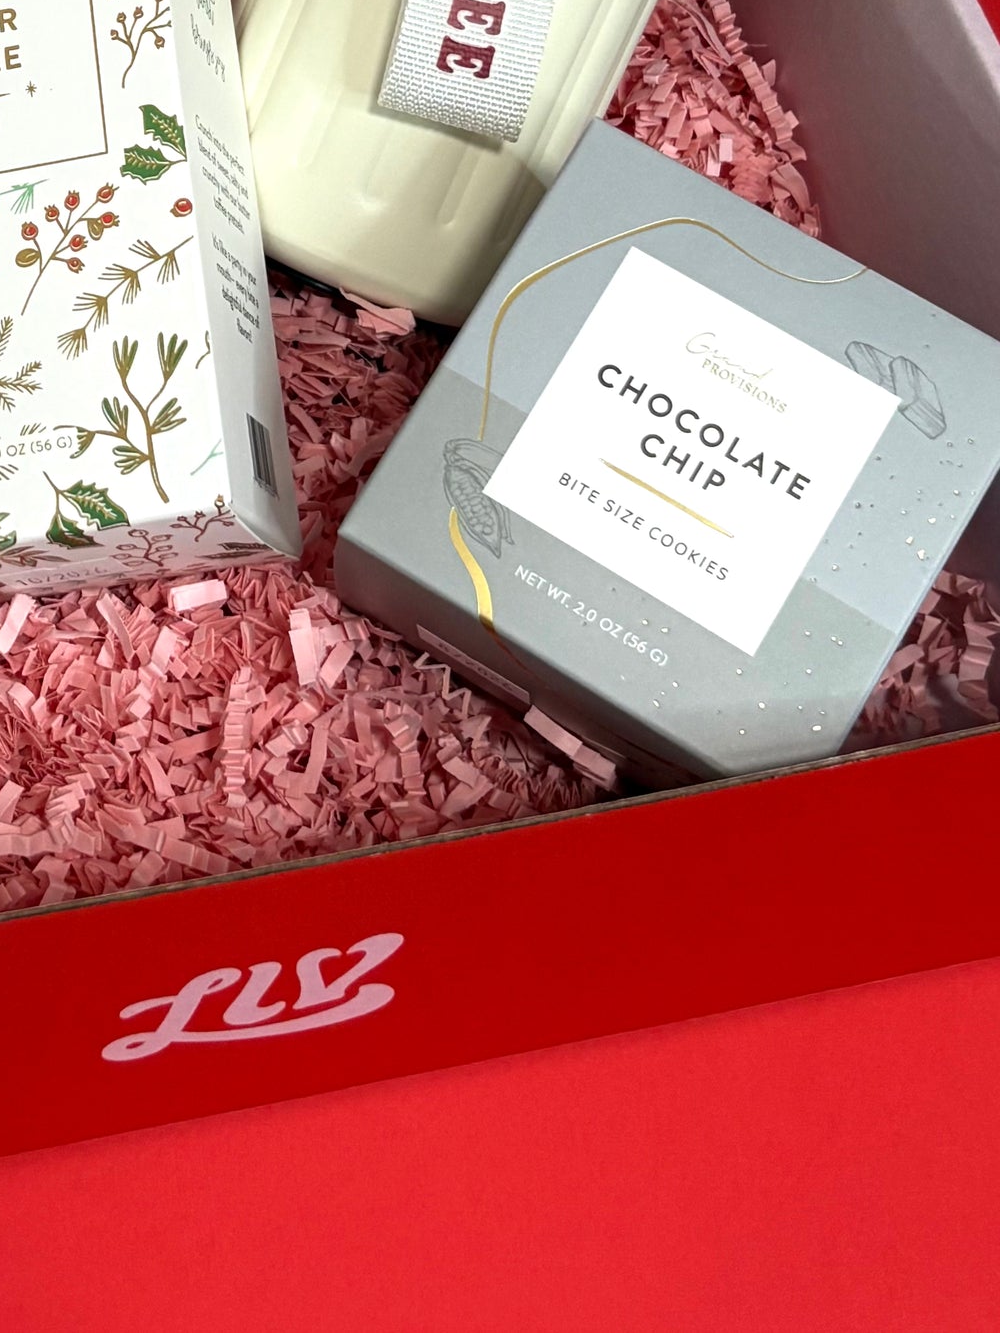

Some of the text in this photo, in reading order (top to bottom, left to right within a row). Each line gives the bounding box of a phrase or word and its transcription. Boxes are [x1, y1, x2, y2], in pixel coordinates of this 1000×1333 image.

[701, 358, 788, 415] PROVISIONS
[6, 443, 26, 457] OZ
[30, 438, 52, 454] (56
[56, 435, 73, 449] G)
[597, 364, 811, 501] CHOCOLATE
[640, 433, 726, 491] CHIP
[558, 472, 730, 583] BITE SIZE COOKIES
[514, 564, 669, 667] NET WT. 2.0 OZ (56 G)
